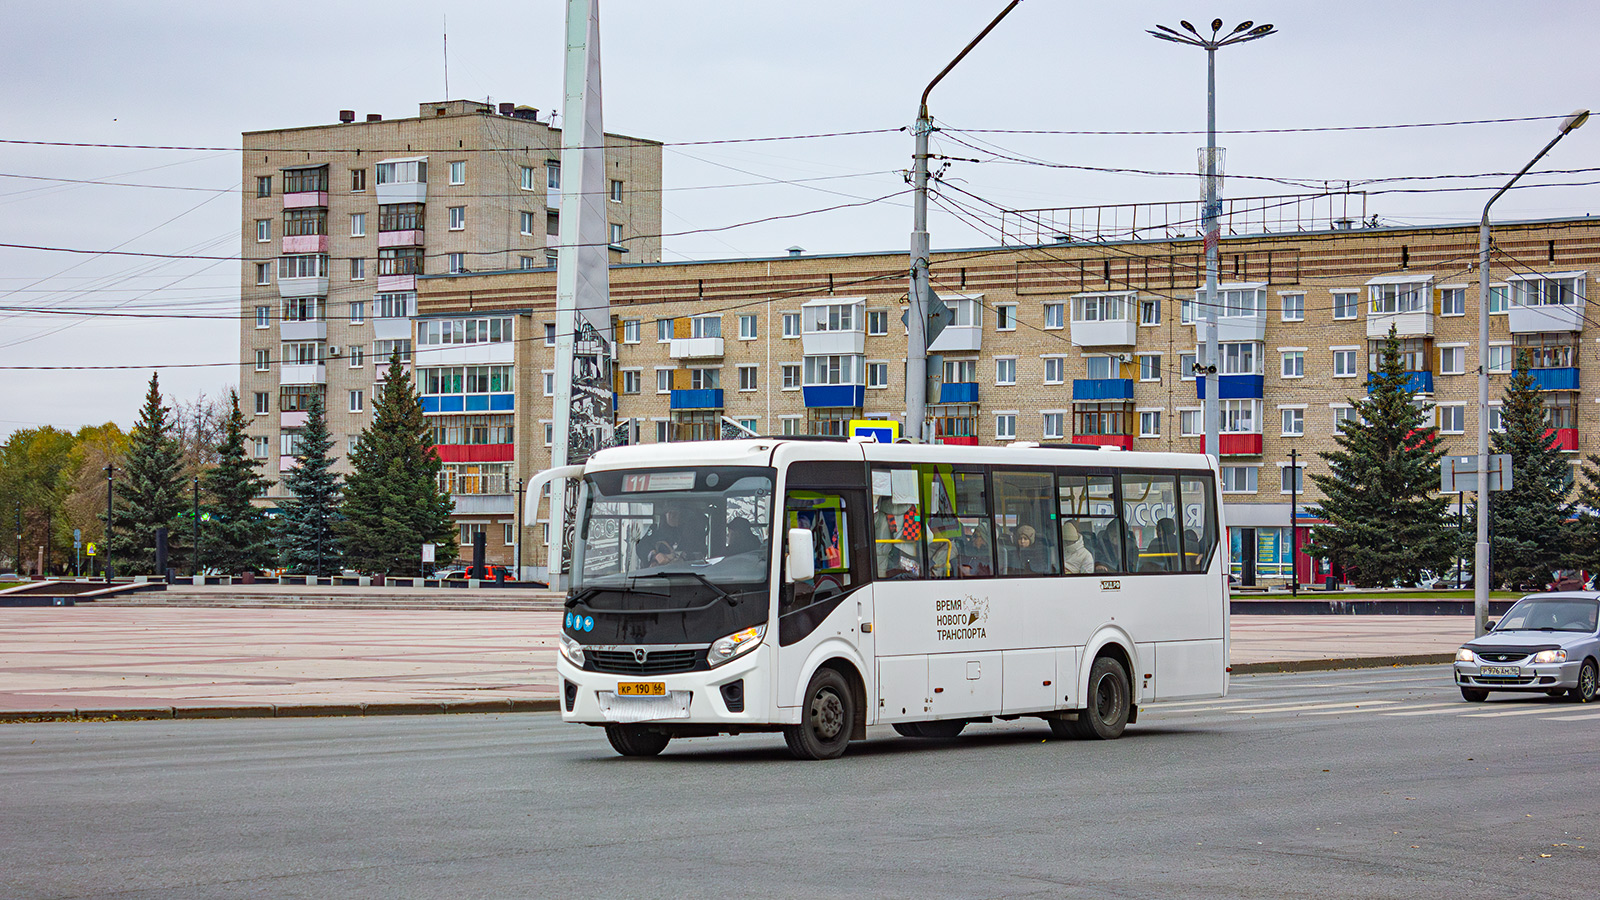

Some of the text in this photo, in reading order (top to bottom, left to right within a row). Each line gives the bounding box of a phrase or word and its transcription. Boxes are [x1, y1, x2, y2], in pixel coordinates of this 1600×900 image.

[631, 475, 646, 491] 11
[936, 599, 962, 611] ВРЕМЯ
[936, 614, 967, 626] НОВОГО
[937, 627, 986, 640] ТРАНСПОРТА
[635, 684, 649, 693] 190
